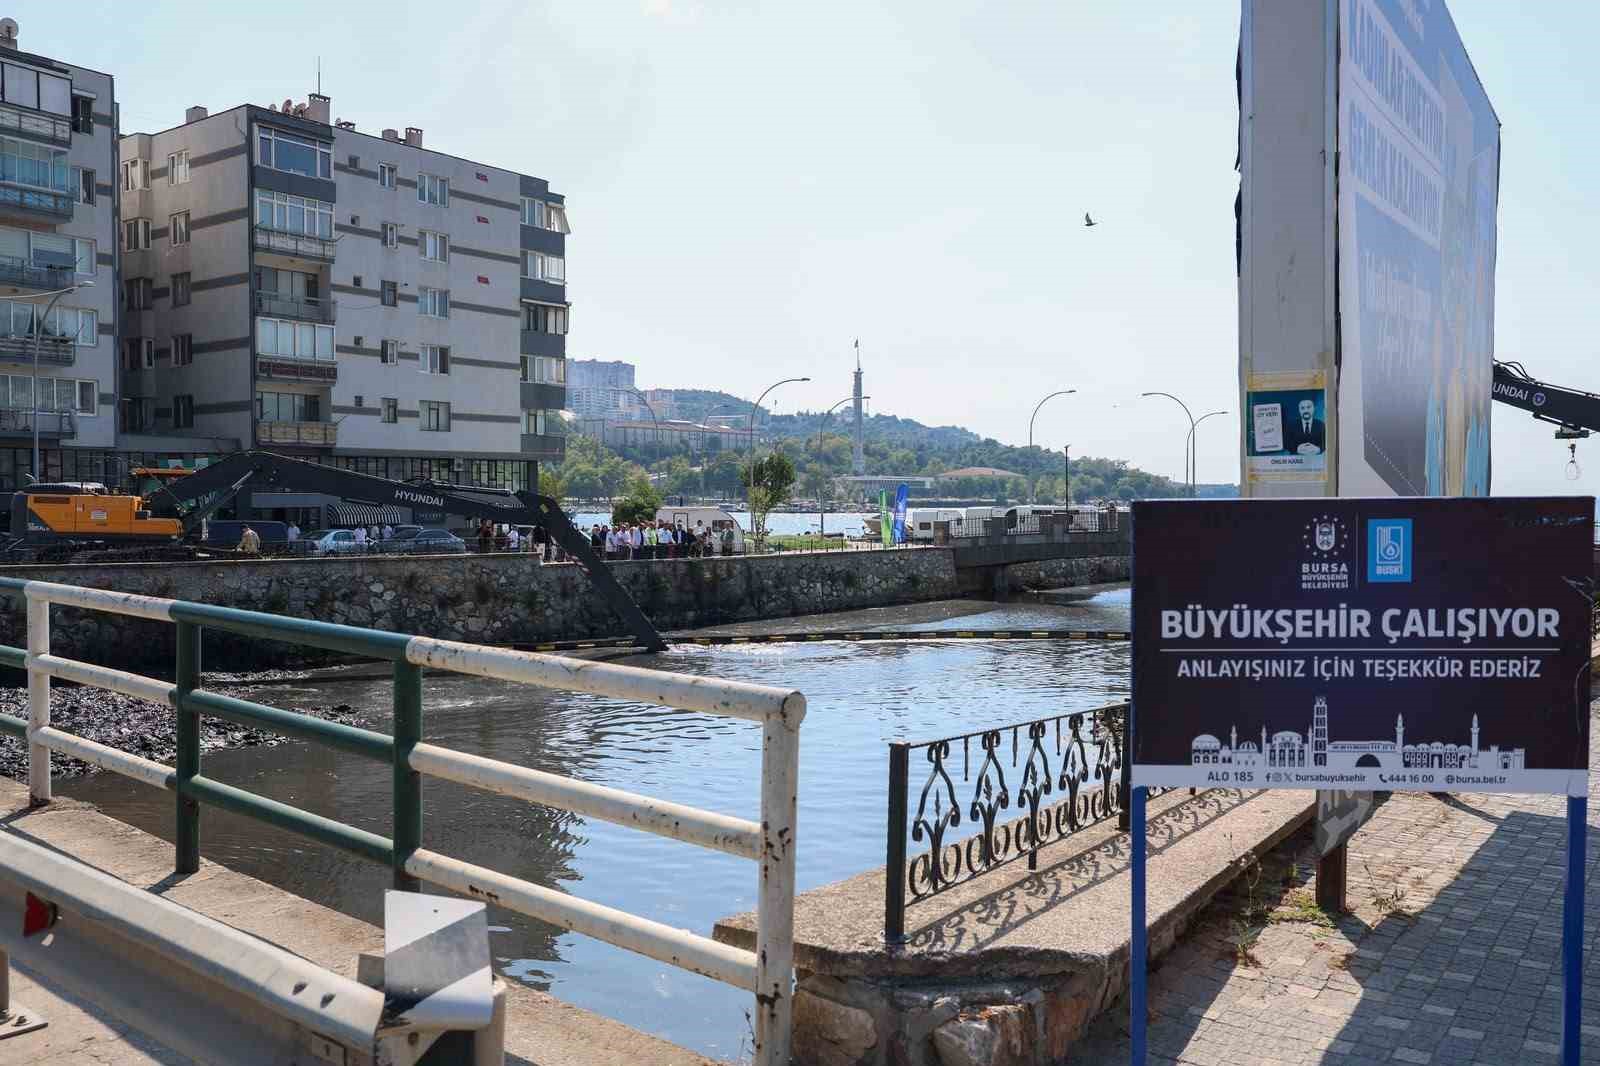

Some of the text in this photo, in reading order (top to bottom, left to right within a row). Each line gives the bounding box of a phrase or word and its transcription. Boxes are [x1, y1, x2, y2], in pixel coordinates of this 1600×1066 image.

[394, 490, 443, 506] HYUNDAI
[1301, 563, 1348, 573] BURSA
[1301, 581, 1349, 589] BELEDİYESİ
[1161, 603, 1560, 643] BÜYÜKŞEHİR ÇALIŞIYOR
[1177, 656, 1541, 681] ANLAYIŞINIZ İÇİN TEŞEKKÜR EDERİZ
[1207, 771, 1254, 782] ALO 185
[1295, 772, 1367, 784] bursabuyuksehir
[1387, 774, 1434, 783] 444 16 00
[1455, 774, 1507, 784] bursa.bel.tr
